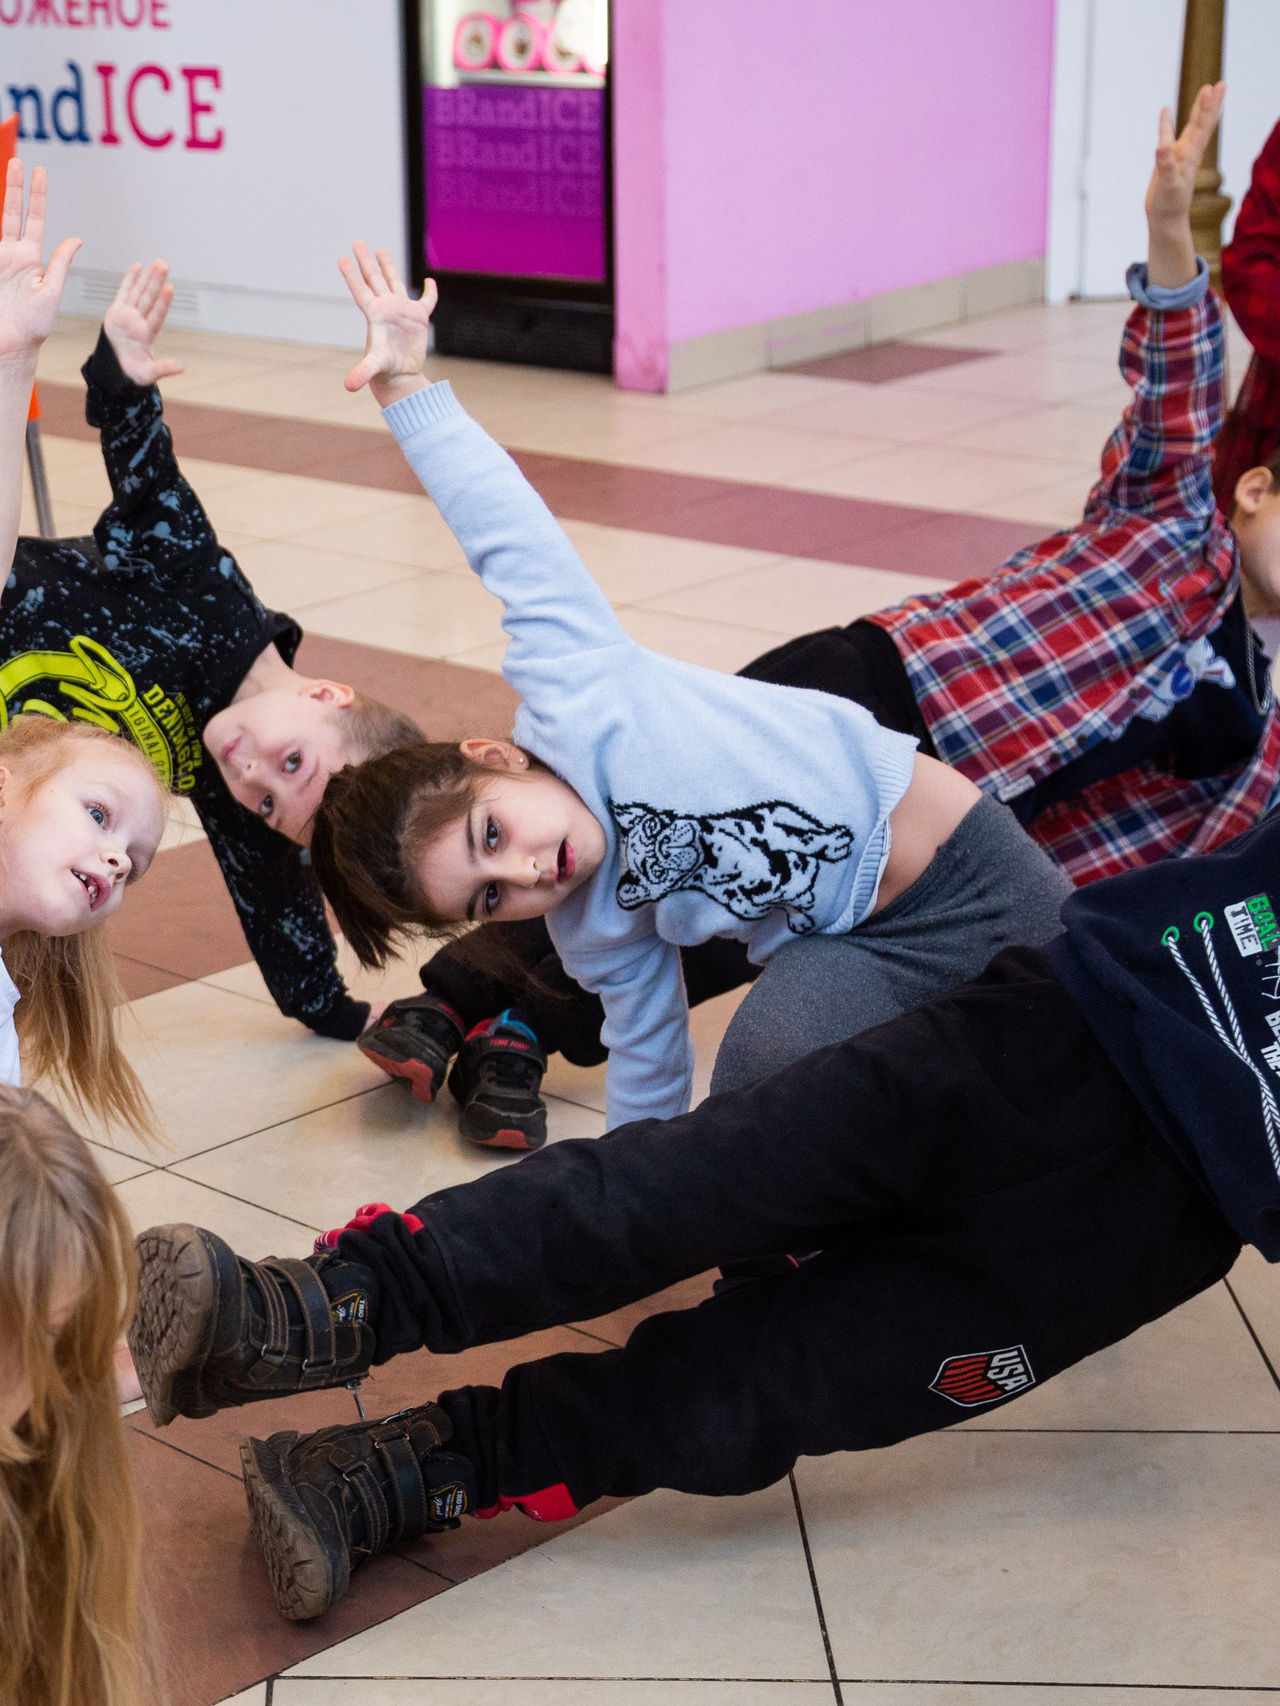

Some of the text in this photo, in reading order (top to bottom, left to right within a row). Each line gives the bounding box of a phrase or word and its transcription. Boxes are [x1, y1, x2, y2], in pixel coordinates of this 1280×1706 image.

[1230, 905, 1259, 950] TIME
[1247, 895, 1280, 950] GOAL
[987, 1350, 1029, 1391] USA
